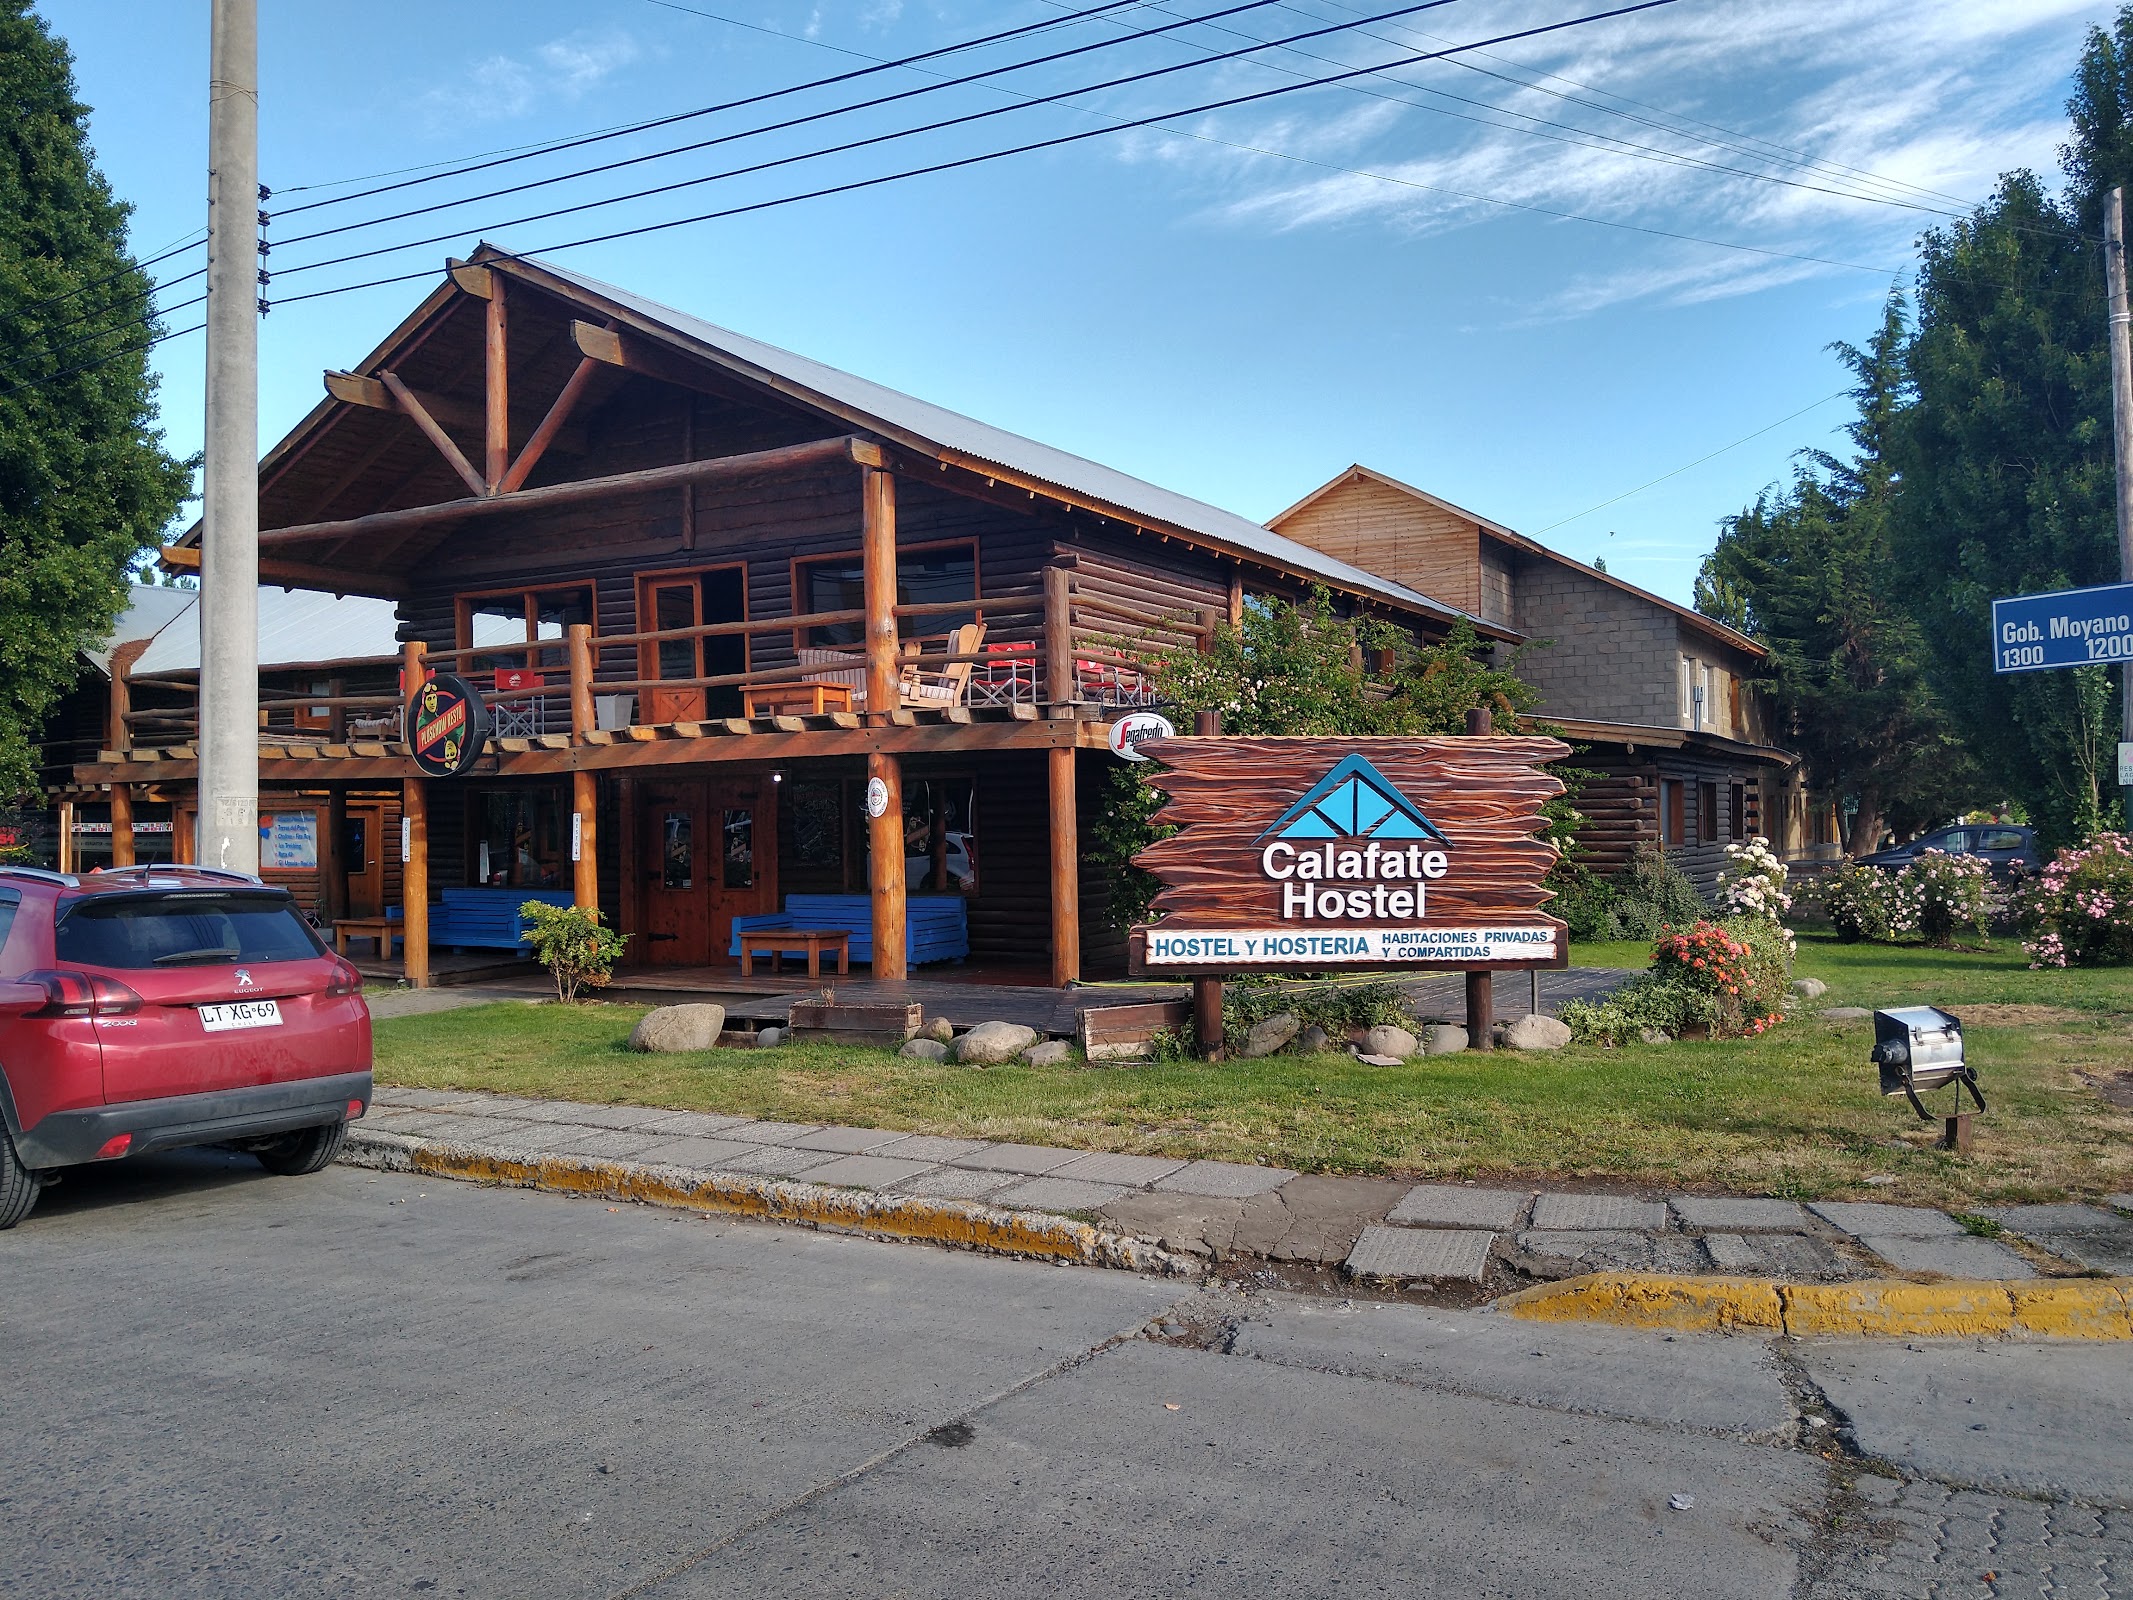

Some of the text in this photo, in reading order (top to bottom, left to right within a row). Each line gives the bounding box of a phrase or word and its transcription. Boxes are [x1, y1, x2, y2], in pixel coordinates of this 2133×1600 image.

[2002, 614, 2130, 644] Gob. Moyano
[2002, 633, 2133, 668] 1300 1200
[447, 705, 463, 728] RESTO
[1262, 841, 1448, 879] Calafate
[1283, 882, 1426, 919] Hostel
[1155, 936, 1370, 957] HOSTEL Y HOSTERIA
[1382, 931, 1548, 944] HABITACIONES PRIVADAS
[1381, 946, 1491, 958] Y COMPARTIDAS
